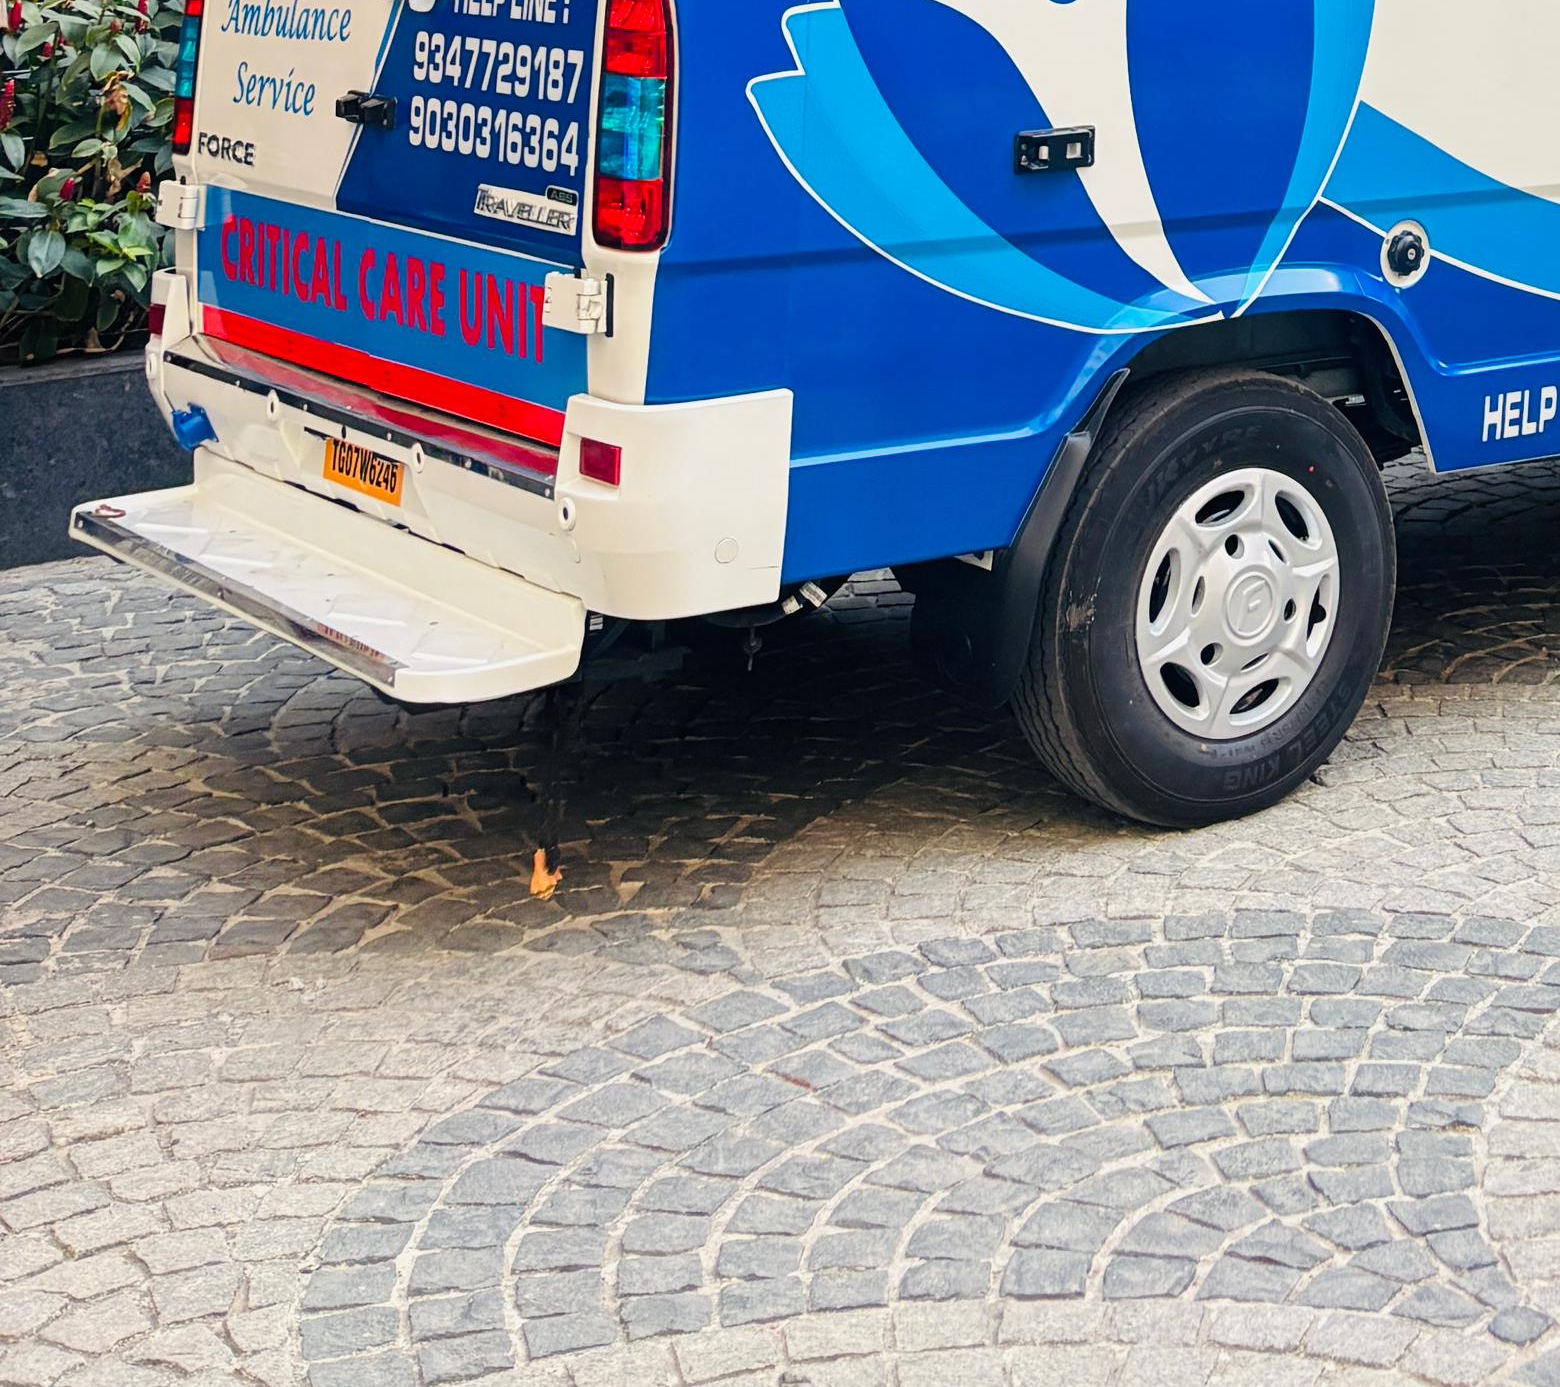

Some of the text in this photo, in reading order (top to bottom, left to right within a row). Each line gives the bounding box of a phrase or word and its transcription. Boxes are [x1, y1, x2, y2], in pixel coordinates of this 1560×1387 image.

[232, 61, 315, 116] Service
[413, 31, 584, 104] 9347729187
[197, 130, 255, 167] FORCE
[408, 95, 579, 177] 9030316364
[221, 214, 546, 364] CRITICAL CARE UNIT
[1481, 384, 1557, 442] HELP
